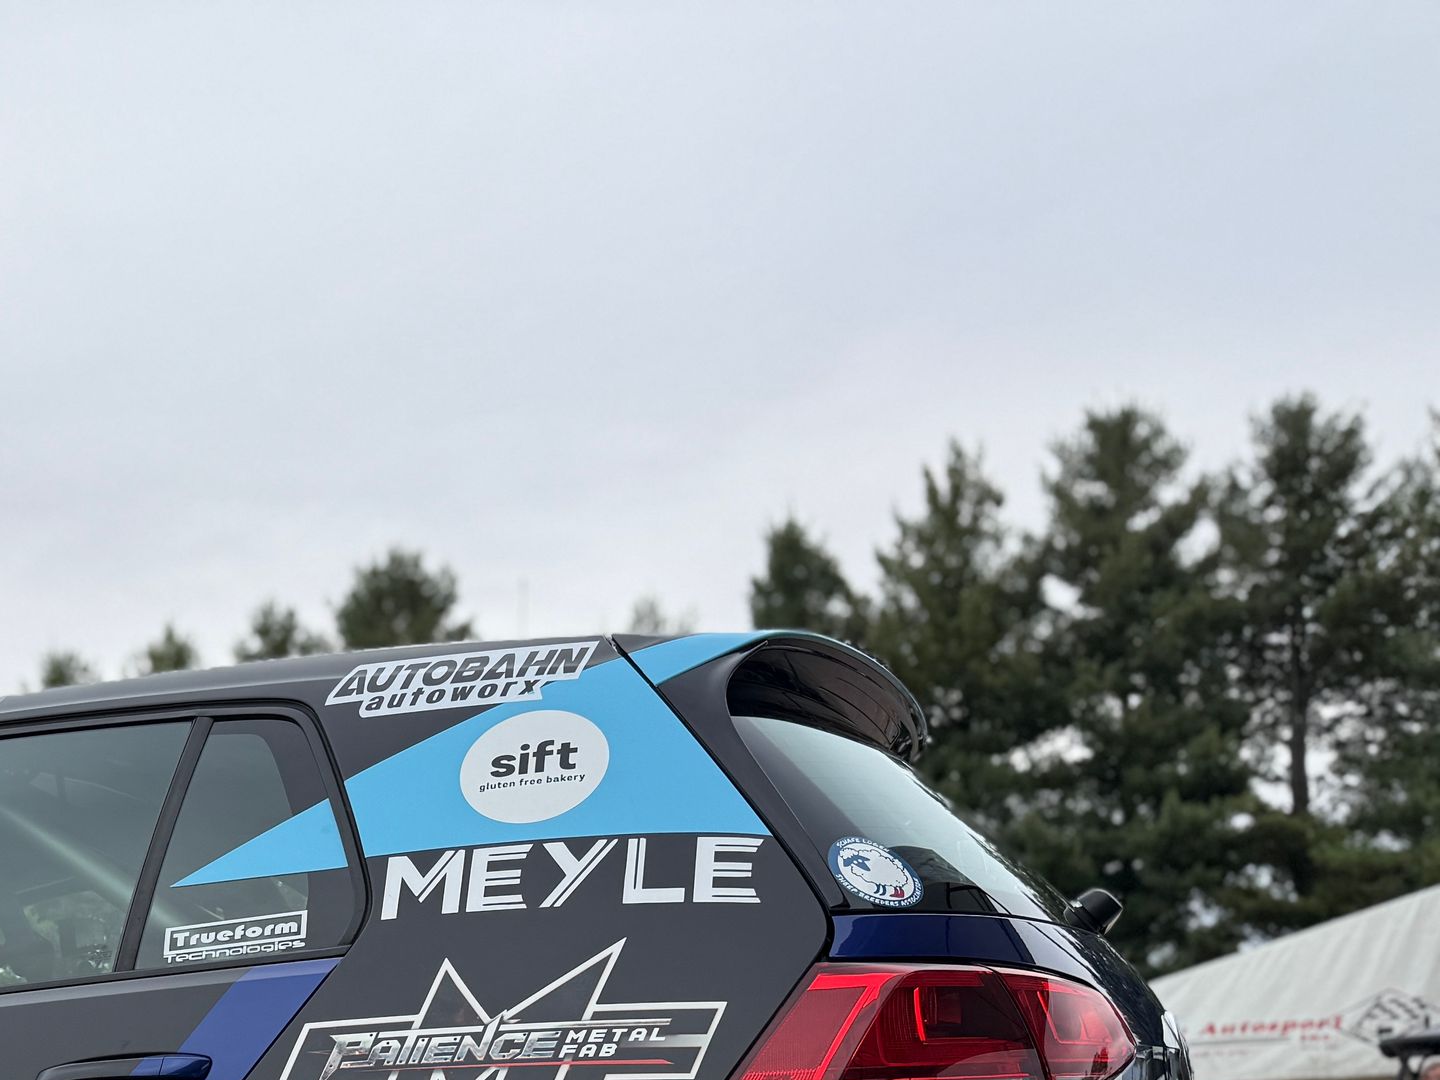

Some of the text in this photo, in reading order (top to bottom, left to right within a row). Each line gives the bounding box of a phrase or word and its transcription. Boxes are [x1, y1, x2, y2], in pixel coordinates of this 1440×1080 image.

[333, 647, 590, 699] AUTOBAHN
[364, 680, 541, 712] autoworx
[490, 739, 578, 778] sift
[479, 773, 586, 793] gluten free bakery
[381, 837, 764, 920] MEYLE
[173, 921, 299, 947] Trueform
[163, 940, 306, 963] Technologies
[564, 1028, 666, 1044] METAL
[558, 1043, 618, 1059] FAB
